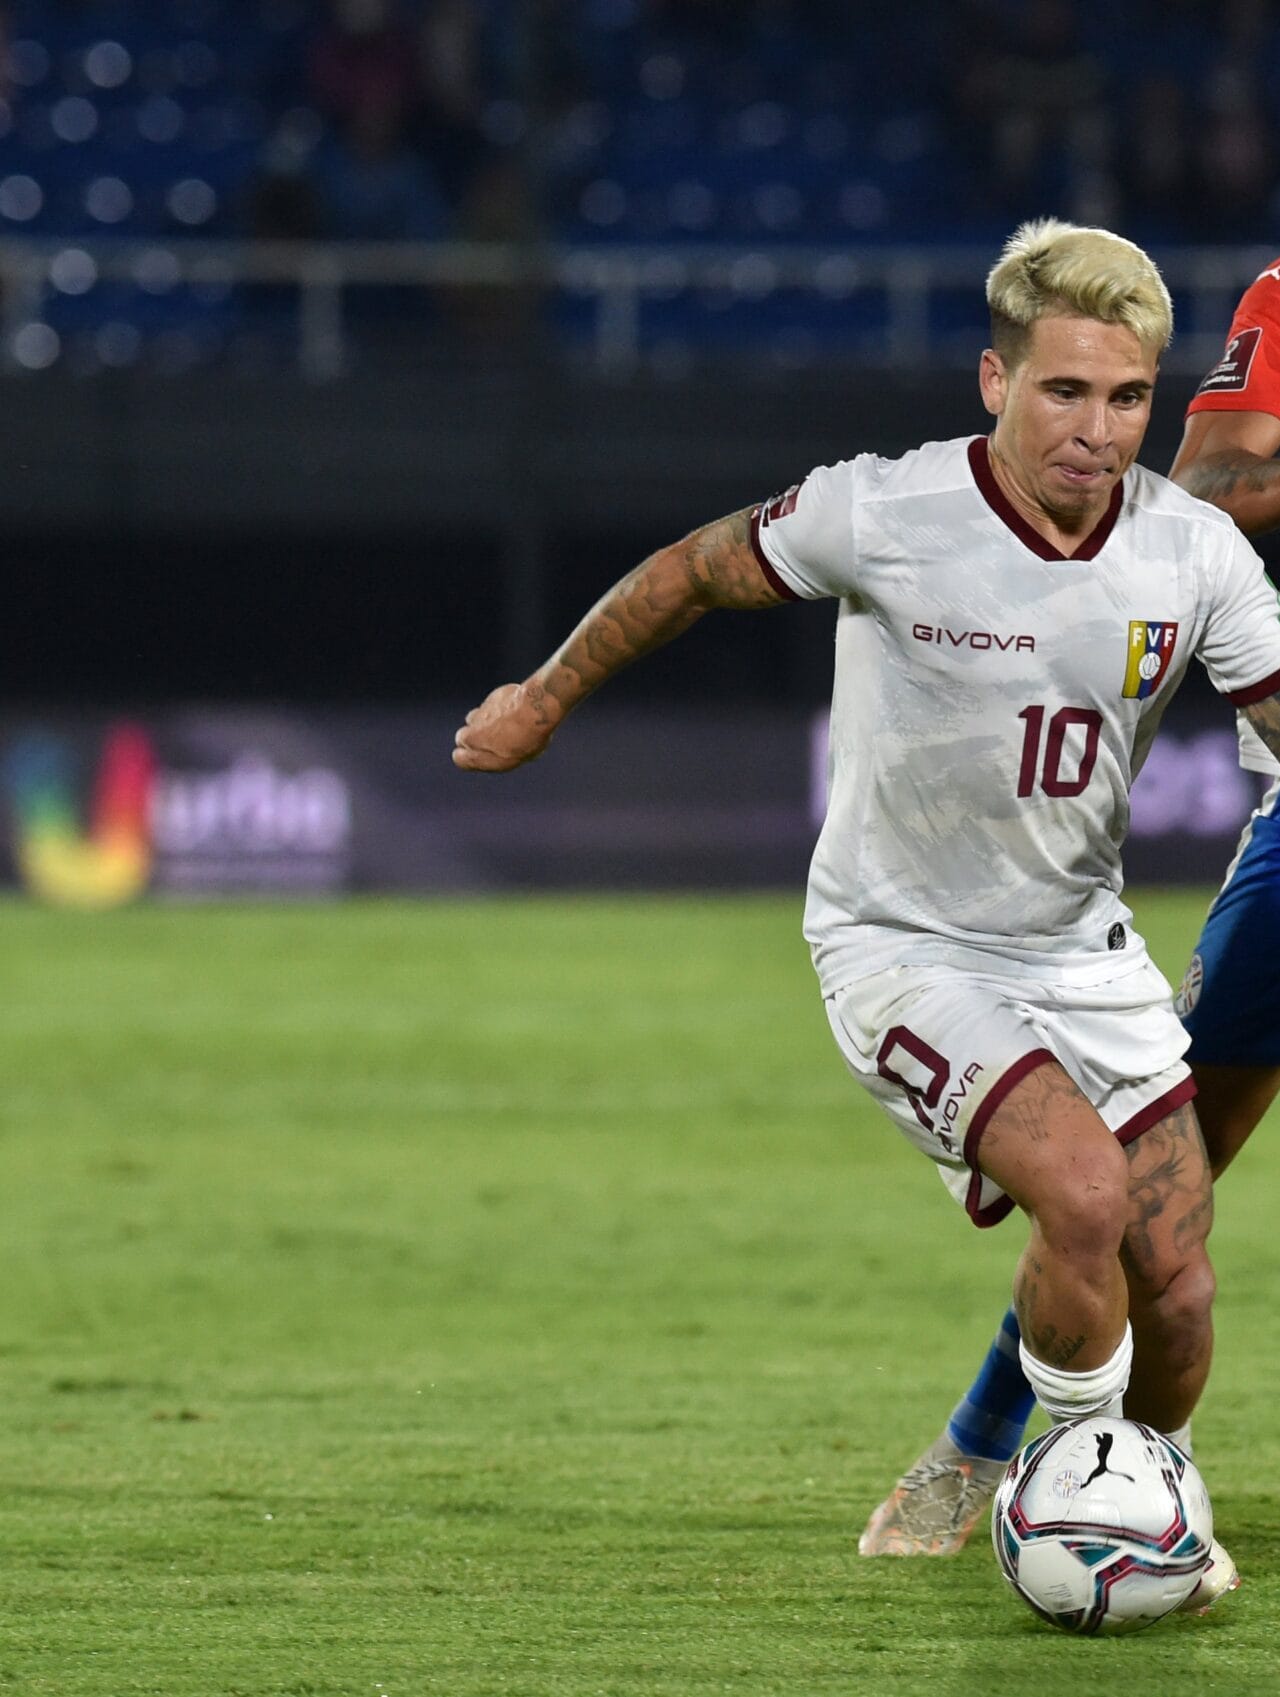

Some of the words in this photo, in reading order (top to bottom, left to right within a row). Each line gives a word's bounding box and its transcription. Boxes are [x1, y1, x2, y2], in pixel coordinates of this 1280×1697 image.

[912, 622, 1036, 653] GIVOVA
[1132, 627, 1175, 648] FVF
[1017, 705, 1104, 798] 10
[939, 1062, 984, 1152] VOVA
